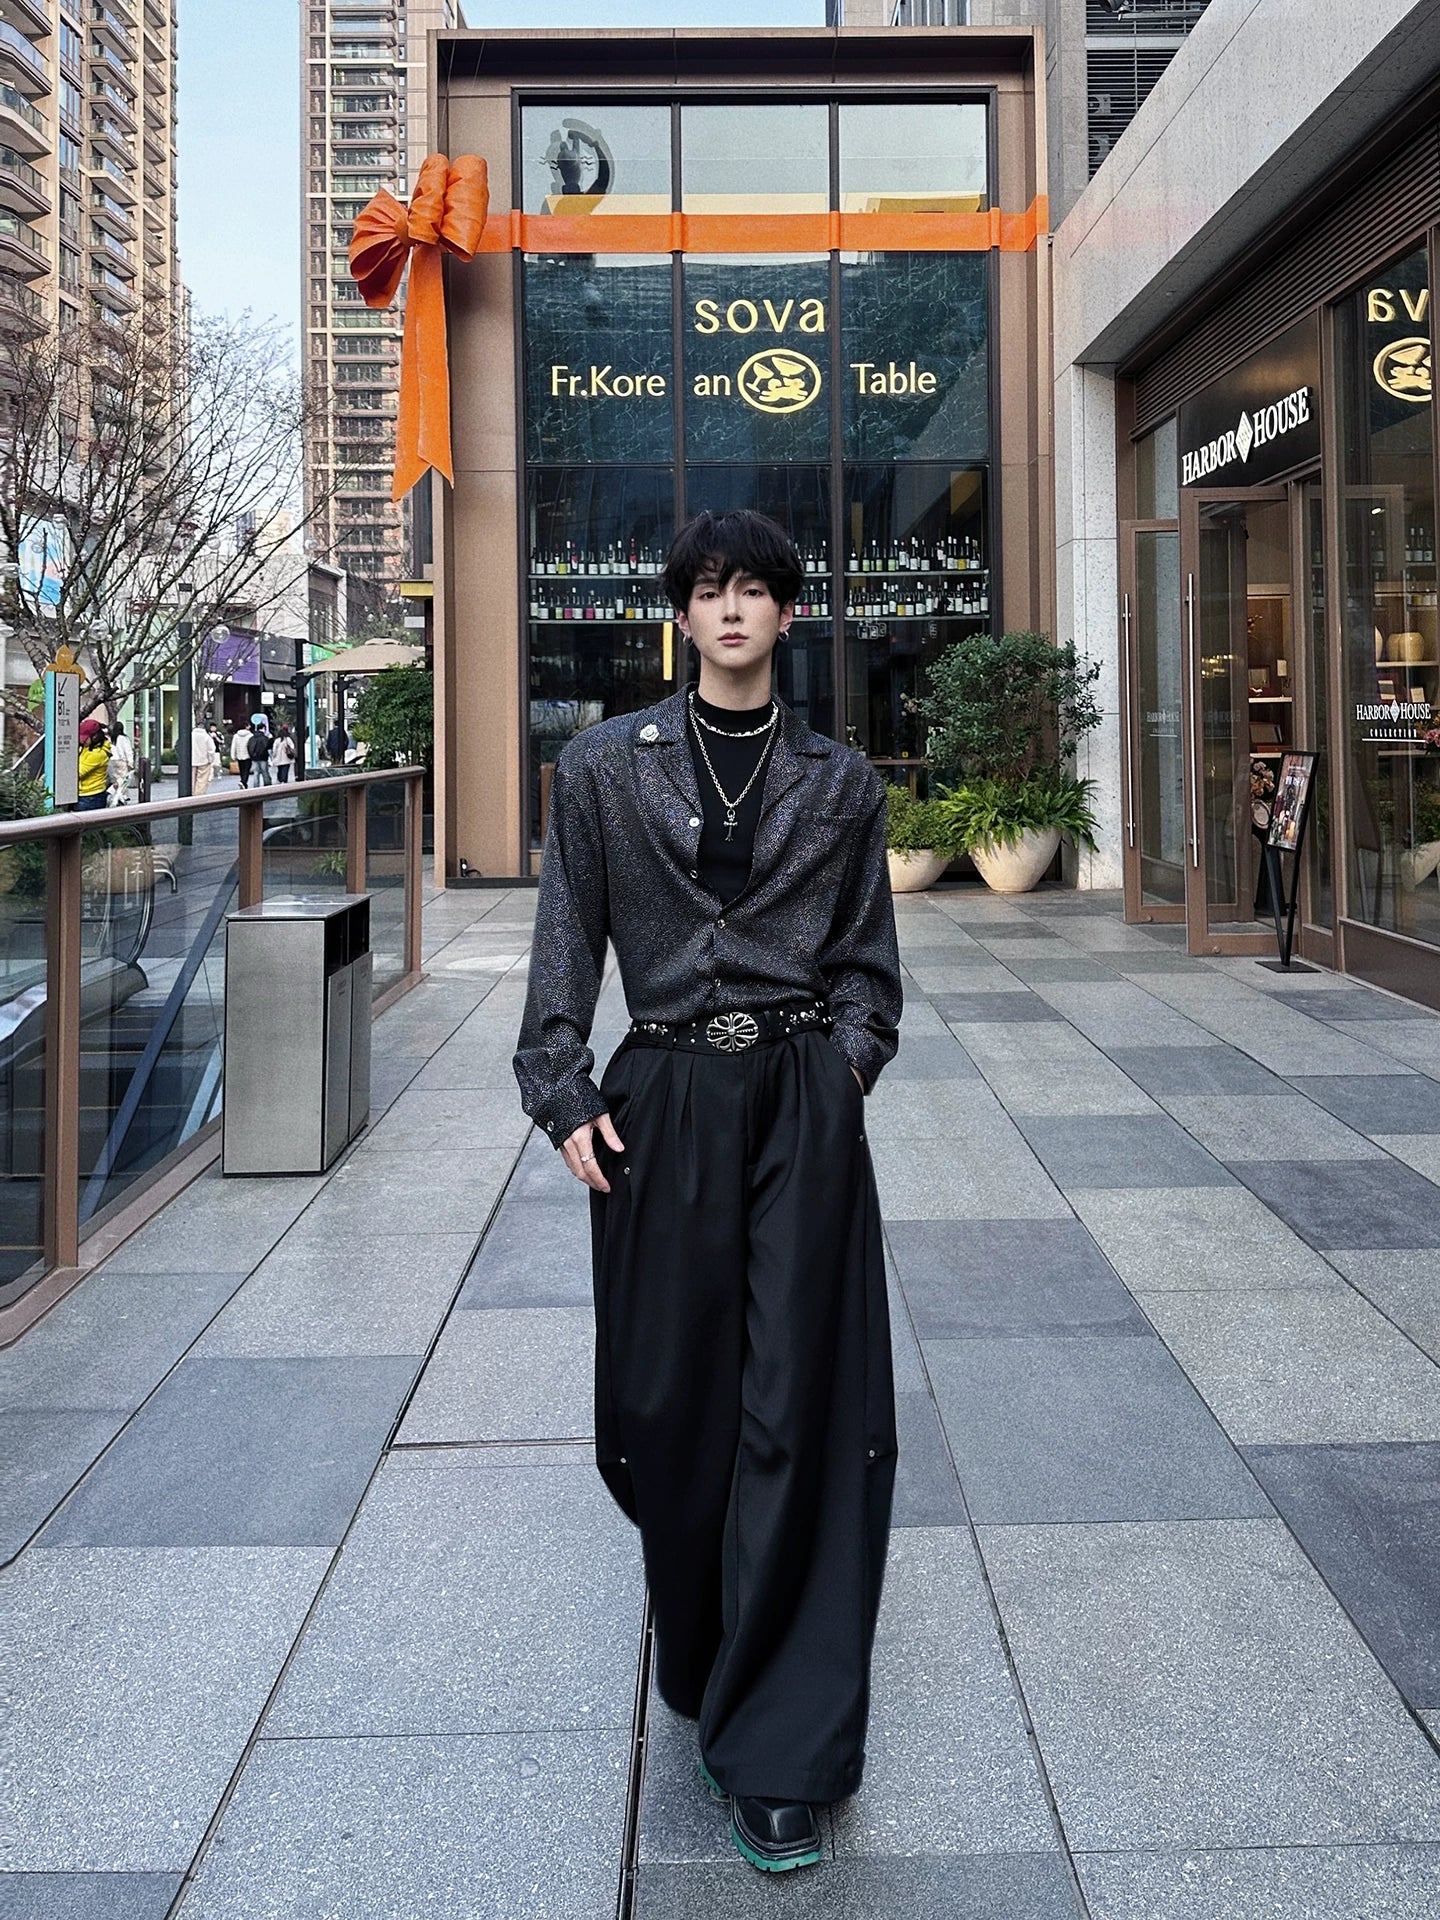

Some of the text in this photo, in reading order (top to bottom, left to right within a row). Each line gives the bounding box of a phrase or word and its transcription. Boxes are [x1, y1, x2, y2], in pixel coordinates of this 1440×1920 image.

[694, 298, 826, 334] sova
[551, 361, 937, 397] Fr.Kore an Table
[1181, 386, 1310, 486] HARBOR HOUSE
[1356, 702, 1432, 720] HARBOR HOUSE
[1369, 728, 1417, 738] COLLECTION
